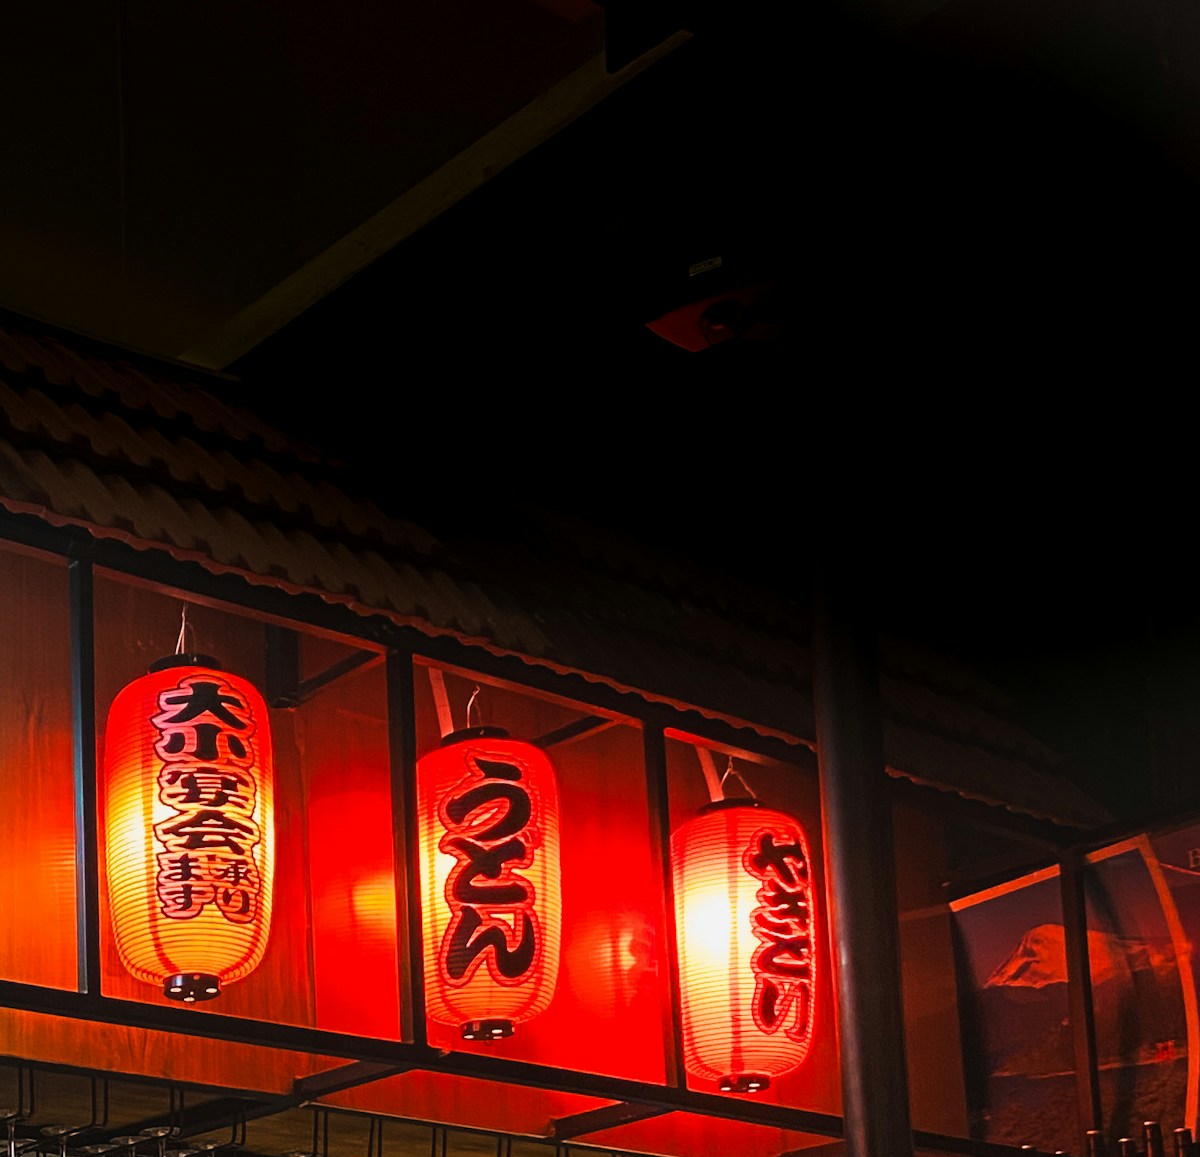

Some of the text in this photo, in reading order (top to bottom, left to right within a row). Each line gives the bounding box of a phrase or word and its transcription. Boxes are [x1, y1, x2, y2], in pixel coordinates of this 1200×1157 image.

[160, 681, 256, 857] 大小宴会
[441, 755, 536, 980] うどん
